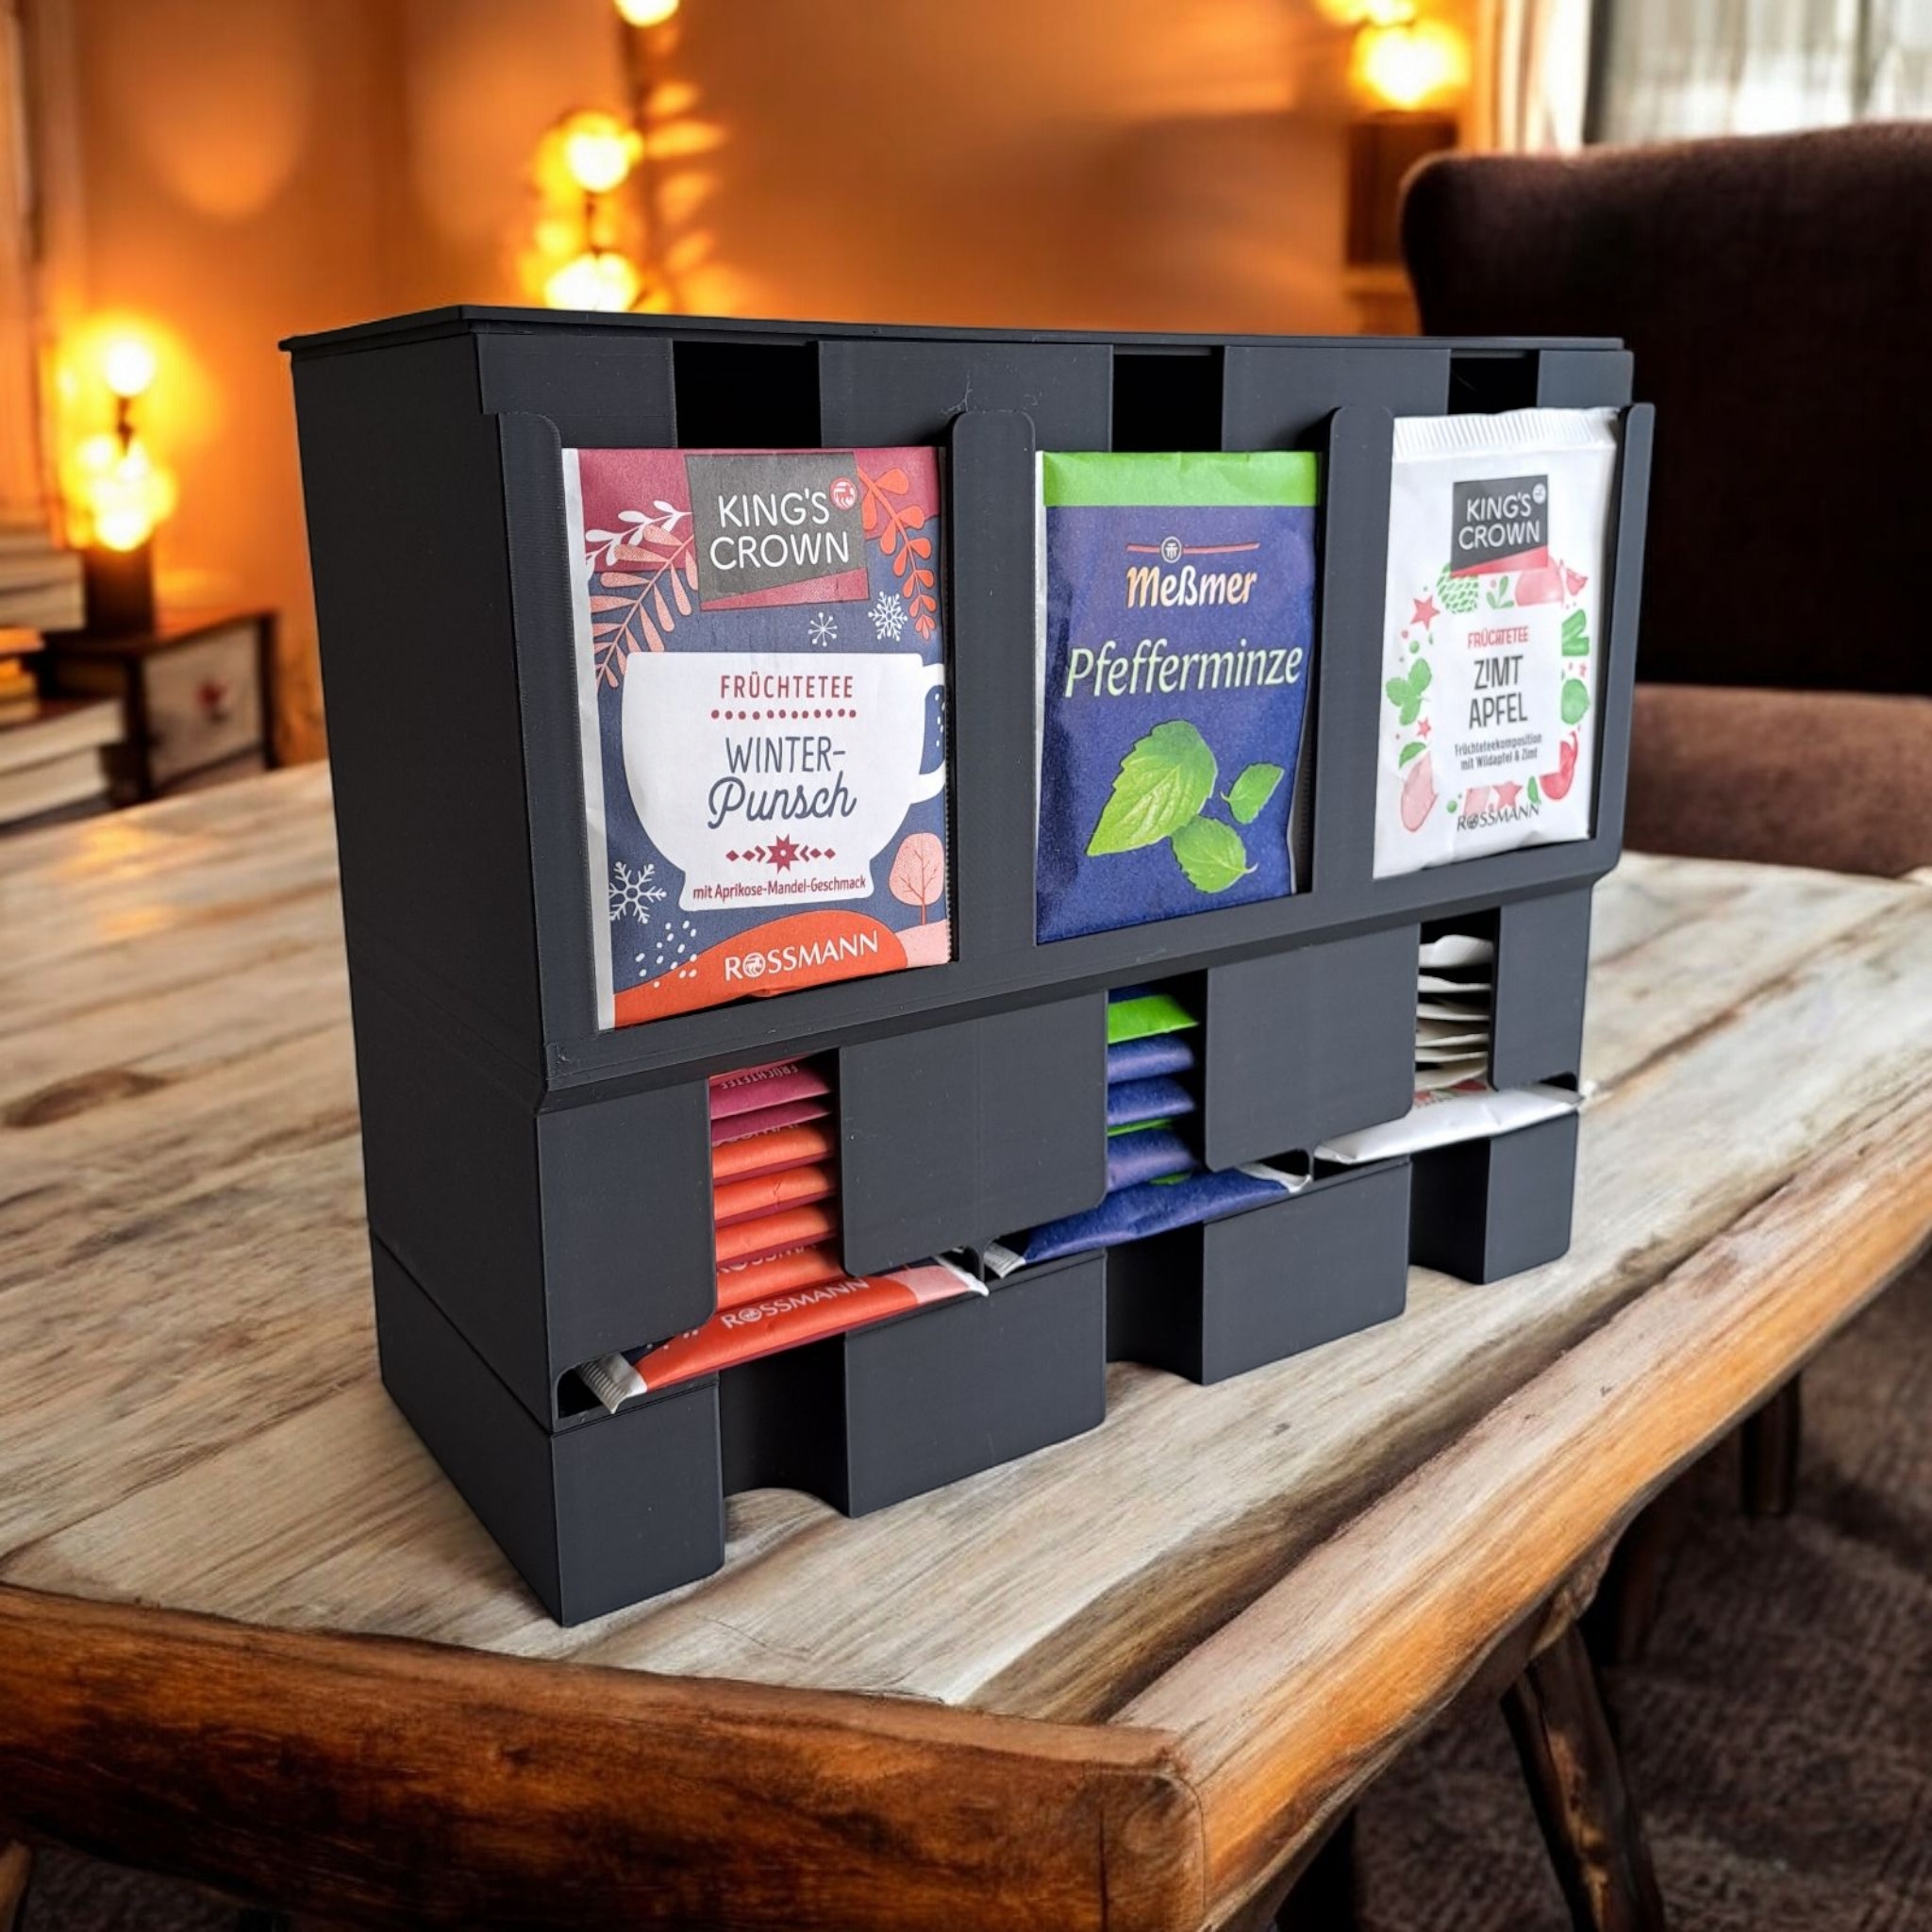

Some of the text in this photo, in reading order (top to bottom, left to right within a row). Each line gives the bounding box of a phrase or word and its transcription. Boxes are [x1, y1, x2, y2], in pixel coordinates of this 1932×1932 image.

[717, 488, 830, 528] KING'S
[1466, 491, 1532, 523] KING'S
[709, 531, 850, 571] CROWN
[1458, 520, 1541, 551] CROWN
[1125, 564, 1258, 608] Meßmer
[1467, 625, 1529, 651] FRÜCHTETEE
[720, 672, 855, 700] FRÜCHTETEE
[1064, 638, 1304, 698] Pfefferminze
[1474, 655, 1524, 691] ZIMT
[1468, 691, 1528, 731] APFEL
[724, 735, 847, 774] WINTER-
[1455, 733, 1542, 757] Früchteteekomposition
[1460, 757, 1474, 771] mit
[1475, 750, 1513, 770] Wildapfel
[1522, 746, 1539, 761] Zimt
[707, 770, 858, 830] Punsch
[1457, 802, 1540, 832] ROSSMANN
[692, 874, 867, 904] mit Aprikose-Mandel-Geschmack
[724, 929, 879, 982] ROSSMANN
[721, 1278, 870, 1329] ROSSMANN
